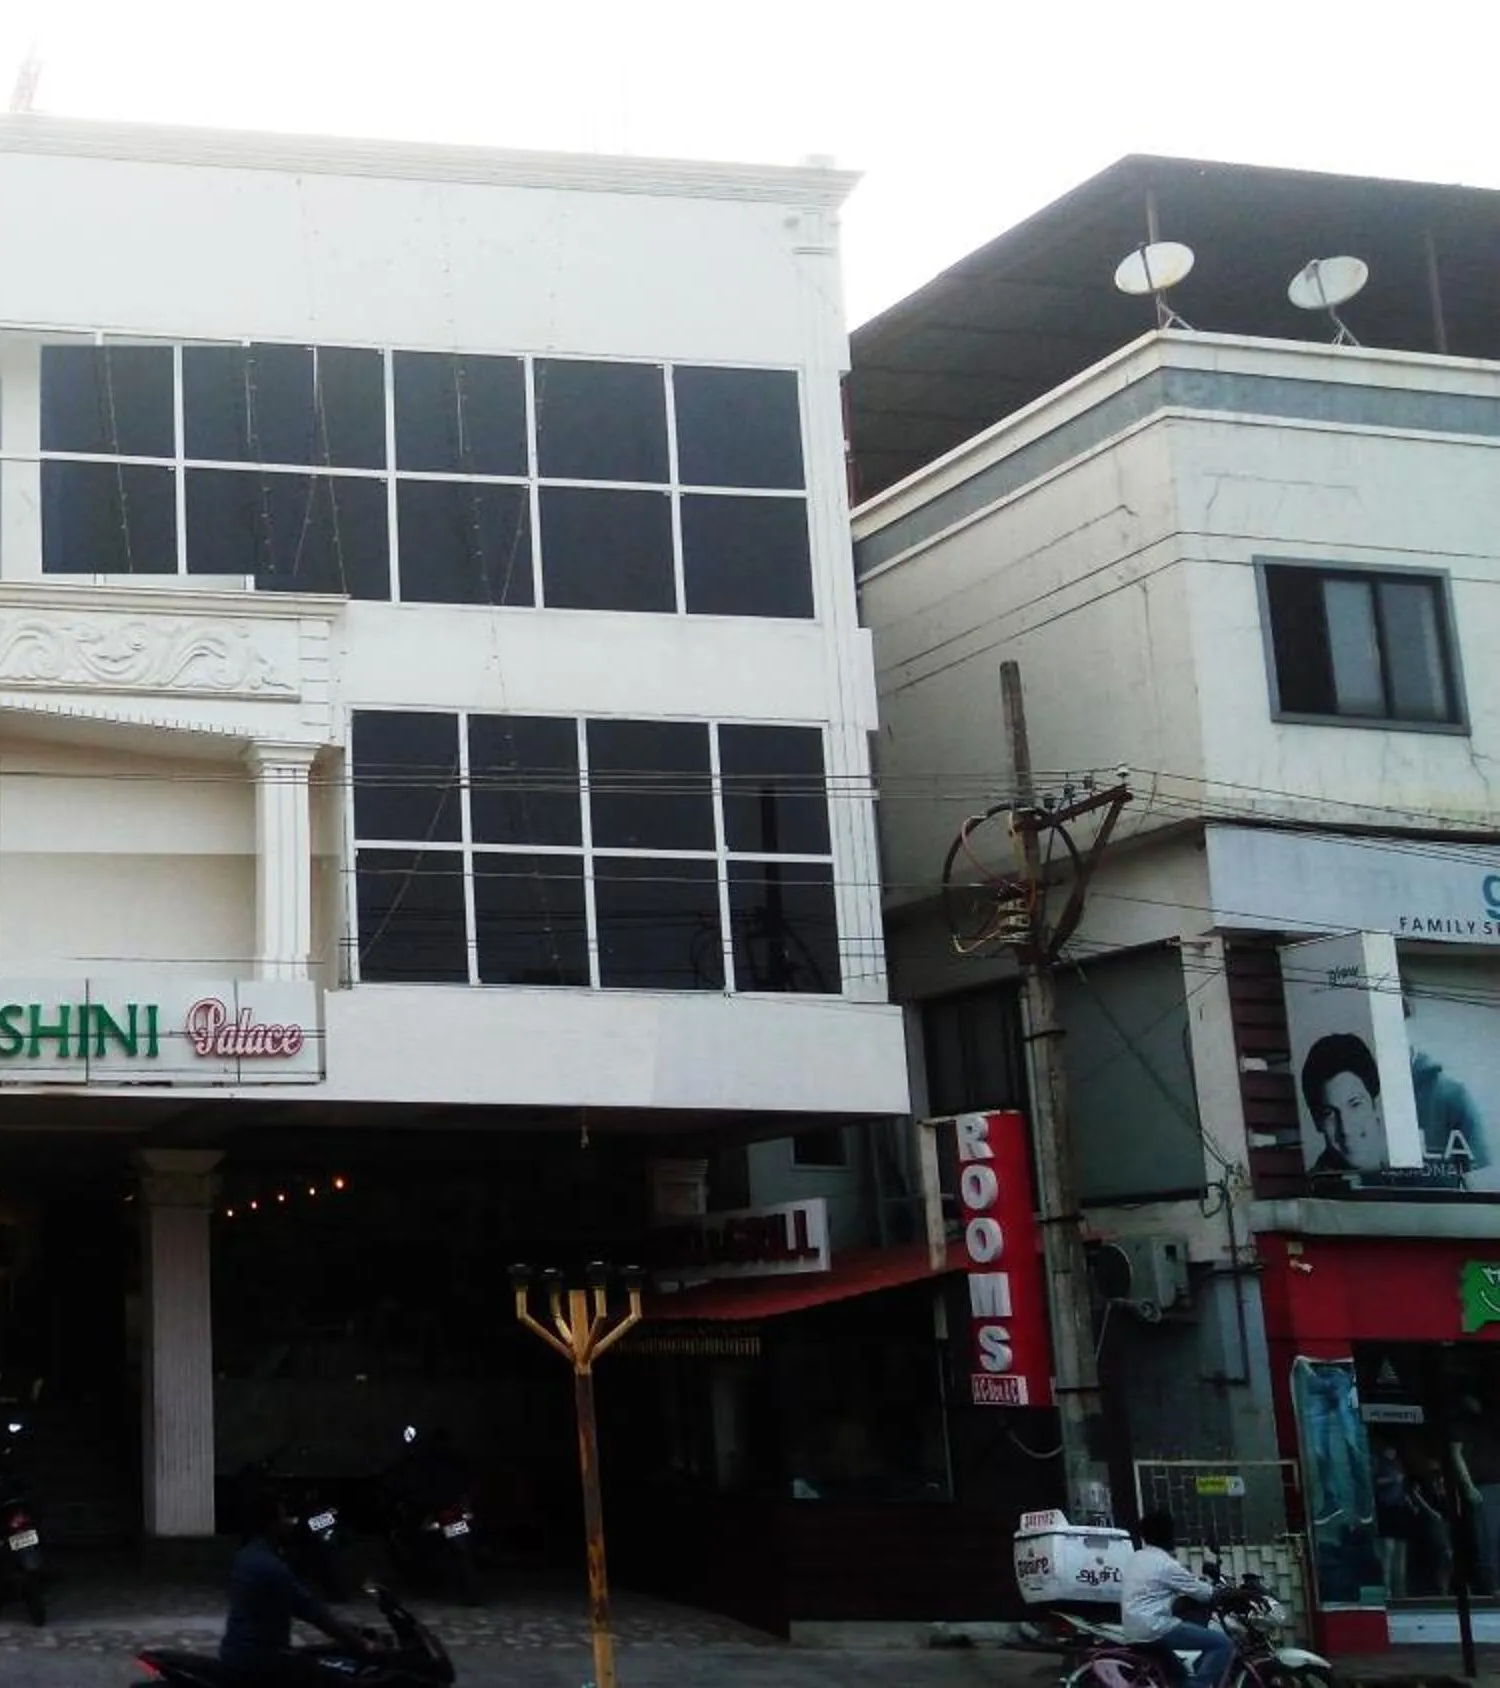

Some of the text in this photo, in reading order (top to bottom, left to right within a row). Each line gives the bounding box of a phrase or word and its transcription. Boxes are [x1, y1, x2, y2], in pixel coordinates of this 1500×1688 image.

[1399, 916, 1475, 935] FAMILY
[186, 998, 304, 1057] Palace
[956, 1113, 1013, 1373] ROOMS
